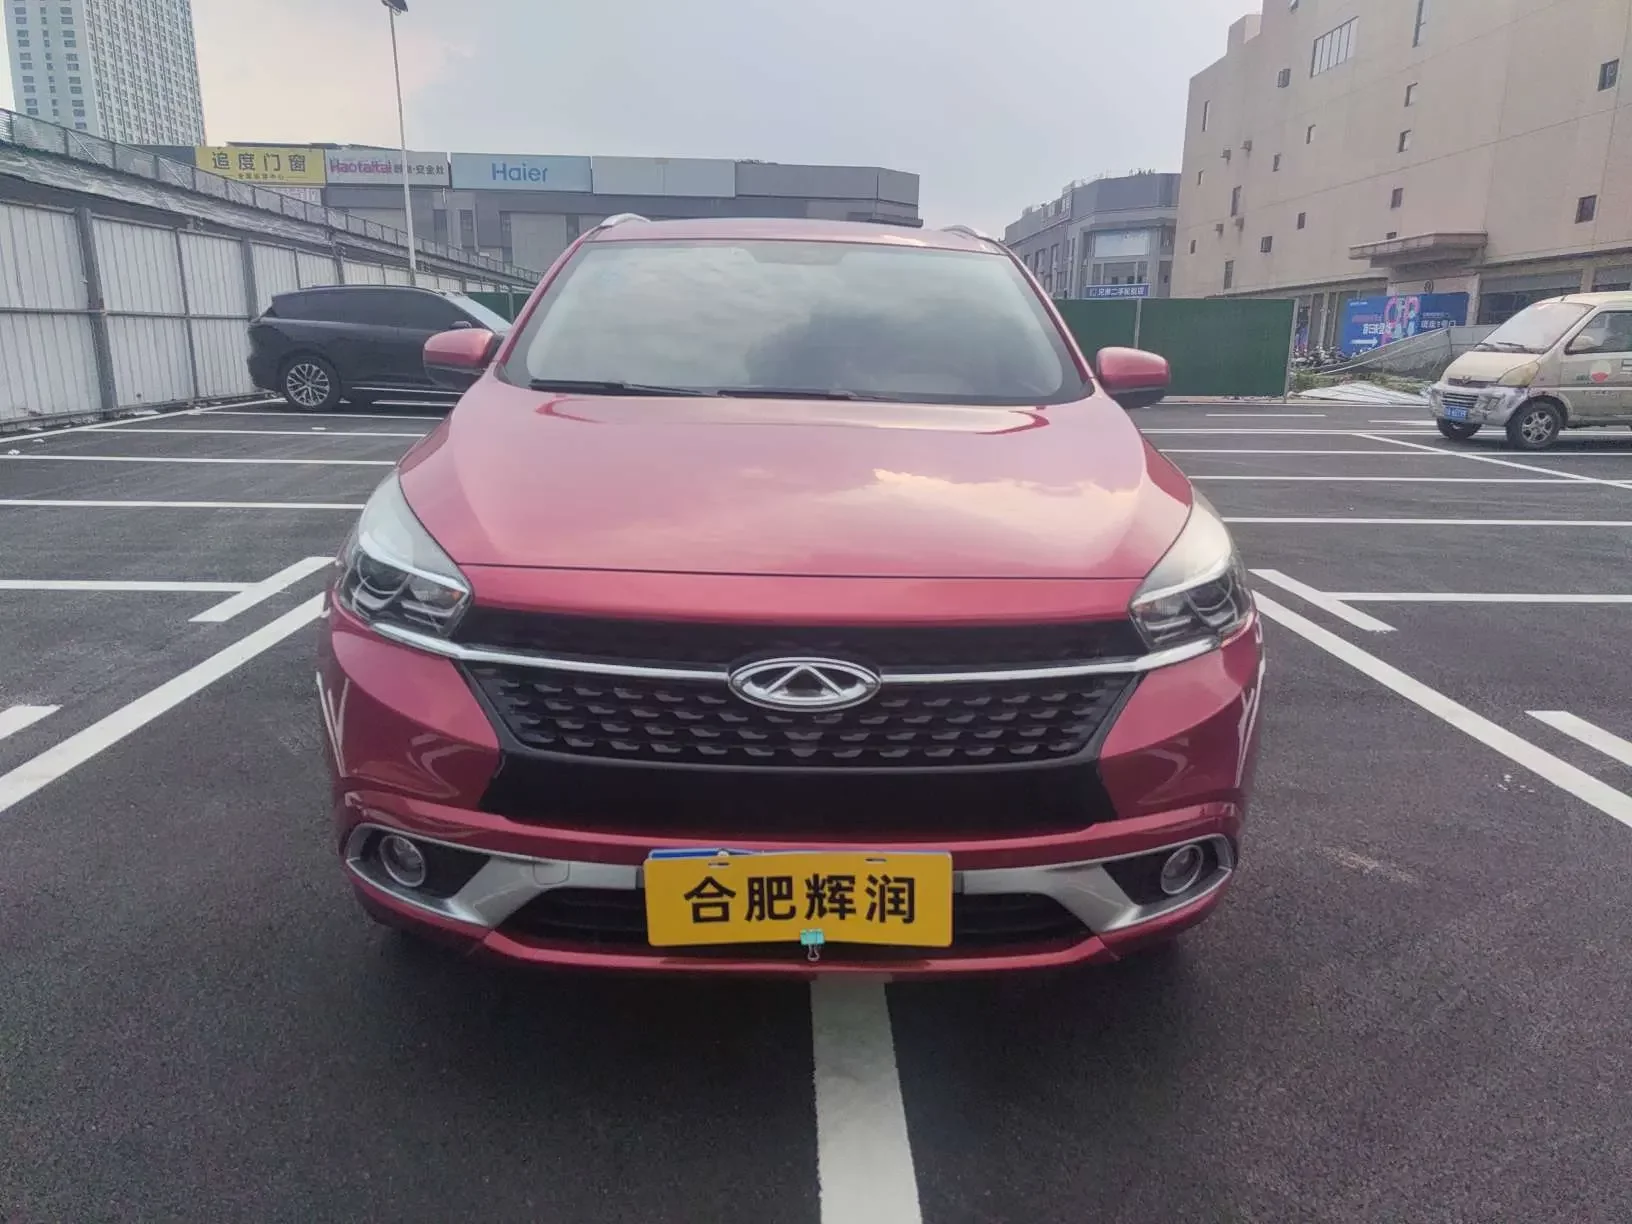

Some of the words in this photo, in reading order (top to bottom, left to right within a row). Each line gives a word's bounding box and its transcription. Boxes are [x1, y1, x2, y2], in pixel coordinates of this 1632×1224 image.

[211, 151, 306, 172] 追度门窗
[329, 157, 392, 174] Haotaitai
[491, 162, 548, 182] Haier
[683, 872, 917, 925] 合肥辉润
